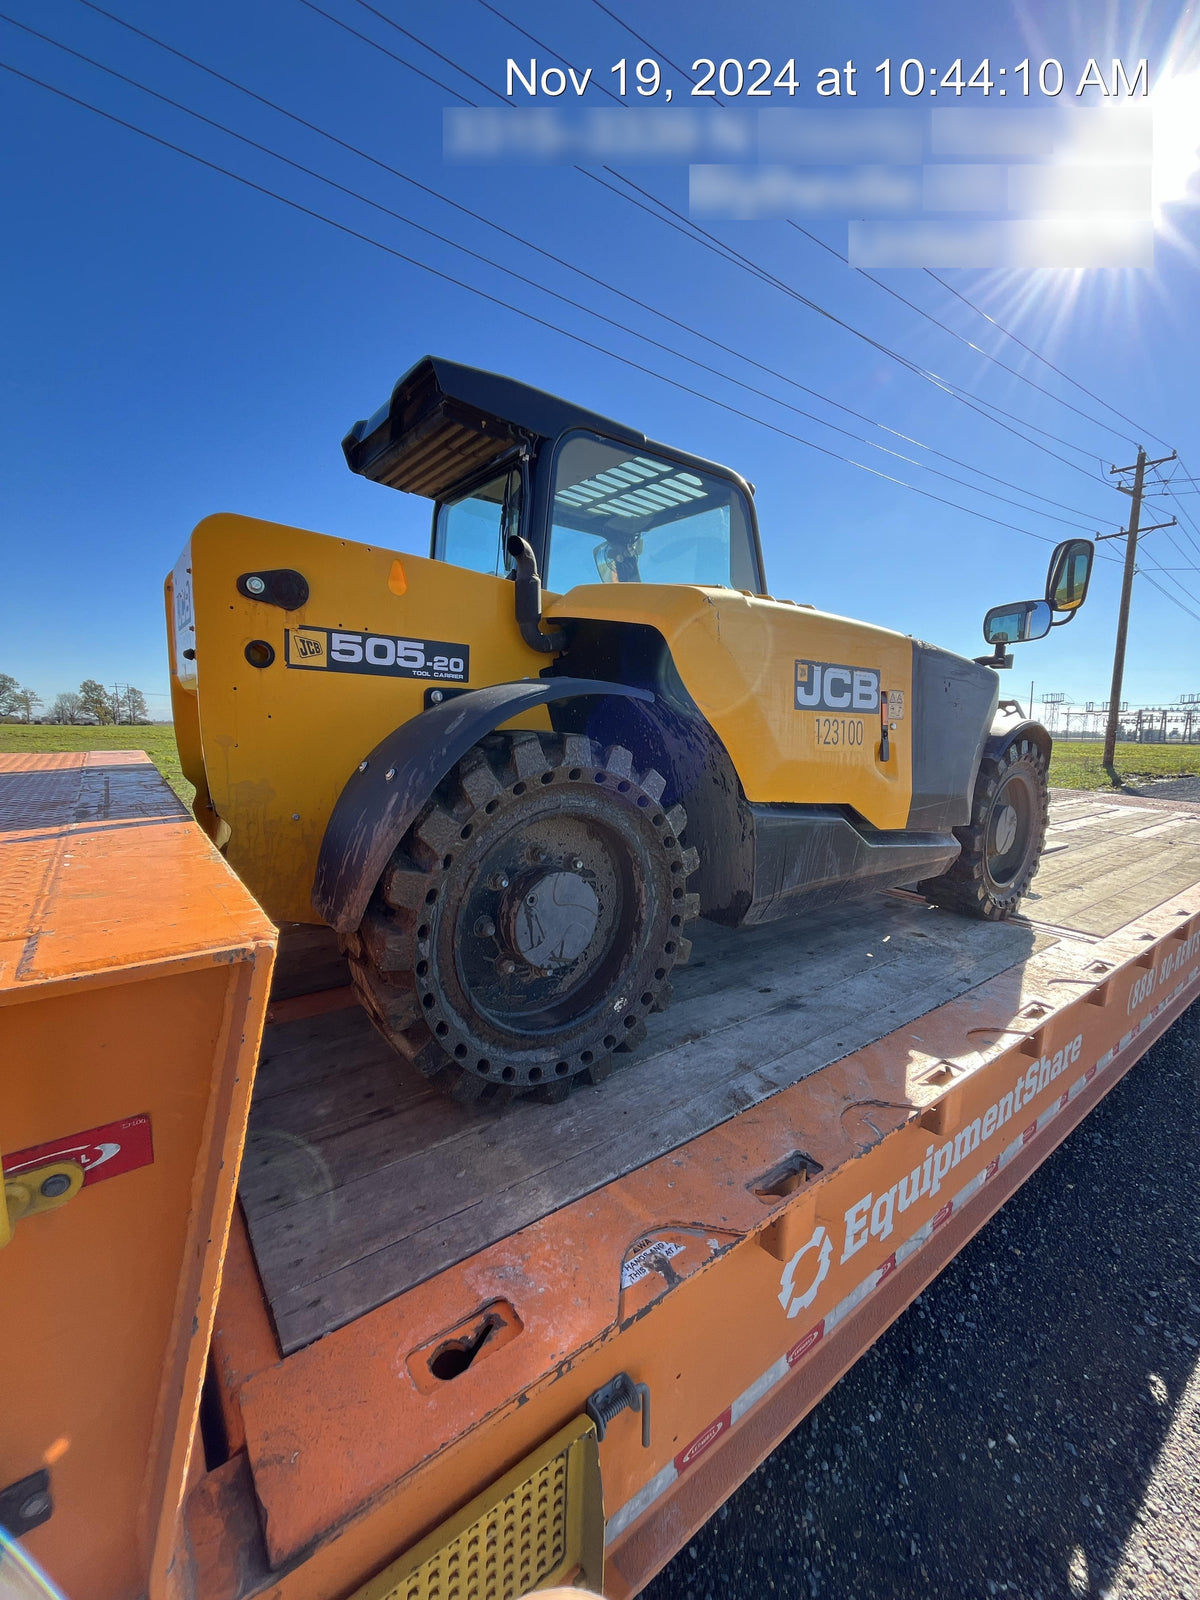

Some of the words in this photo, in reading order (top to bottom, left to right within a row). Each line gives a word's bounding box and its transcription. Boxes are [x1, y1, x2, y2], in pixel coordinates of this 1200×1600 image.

[299, 638, 322, 656] JCB
[331, 632, 464, 672] 505-20
[433, 671, 464, 680] CARRIER
[796, 665, 879, 709] JCB
[815, 718, 864, 746] 123100
[1127, 965, 1158, 1016] (888)
[840, 1033, 1083, 1266] EquipmentShare
[628, 1267, 647, 1280] THIS
[665, 1247, 675, 1257] AT
